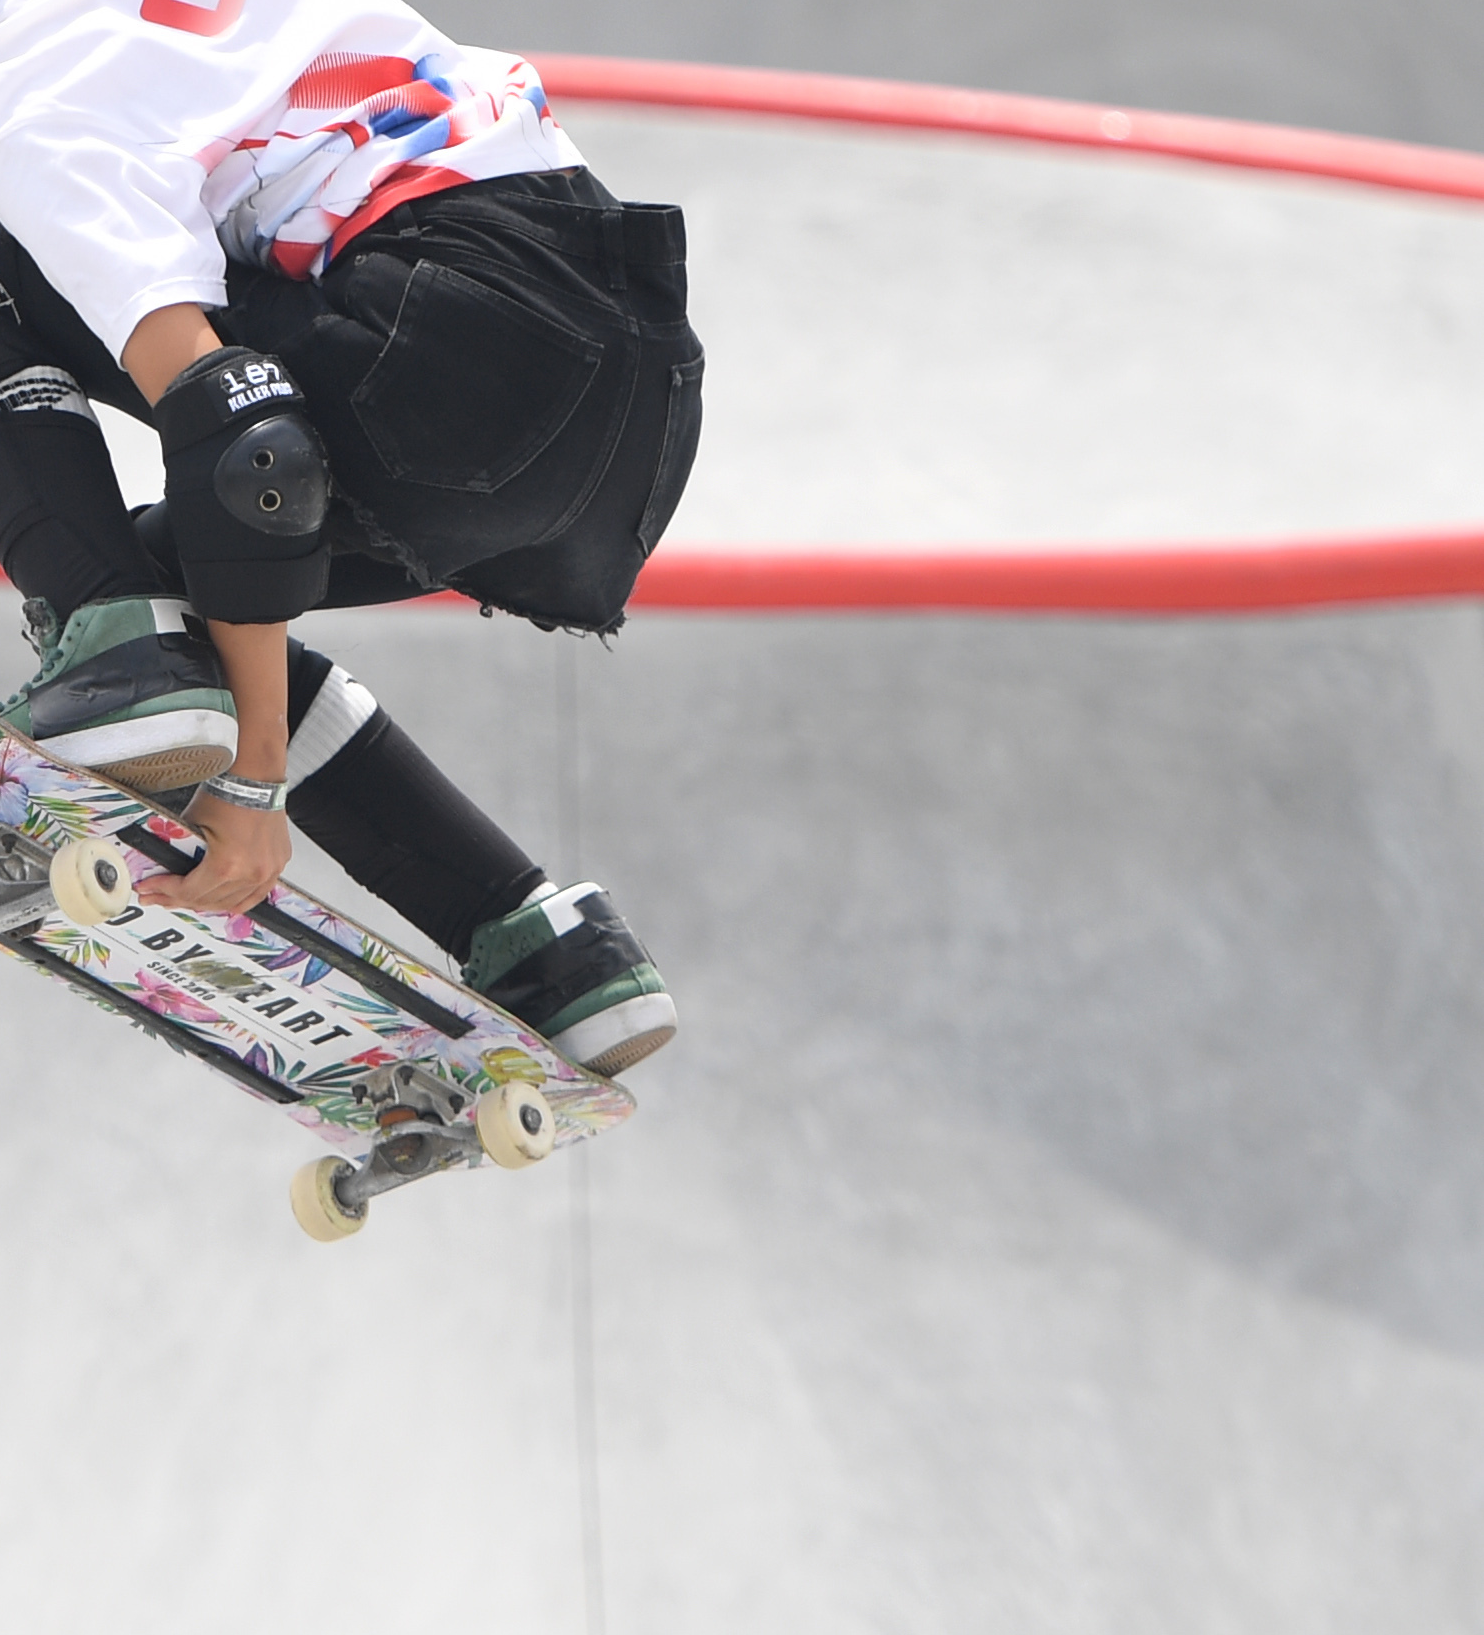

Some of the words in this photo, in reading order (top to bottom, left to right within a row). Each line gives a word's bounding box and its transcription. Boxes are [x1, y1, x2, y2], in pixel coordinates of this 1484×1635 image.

[223, 362, 281, 394] 187
[227, 384, 272, 413] KILLER
[139, 927, 214, 964] BY
[207, 963, 353, 1046] EART
[146, 961, 187, 990] SINCE
